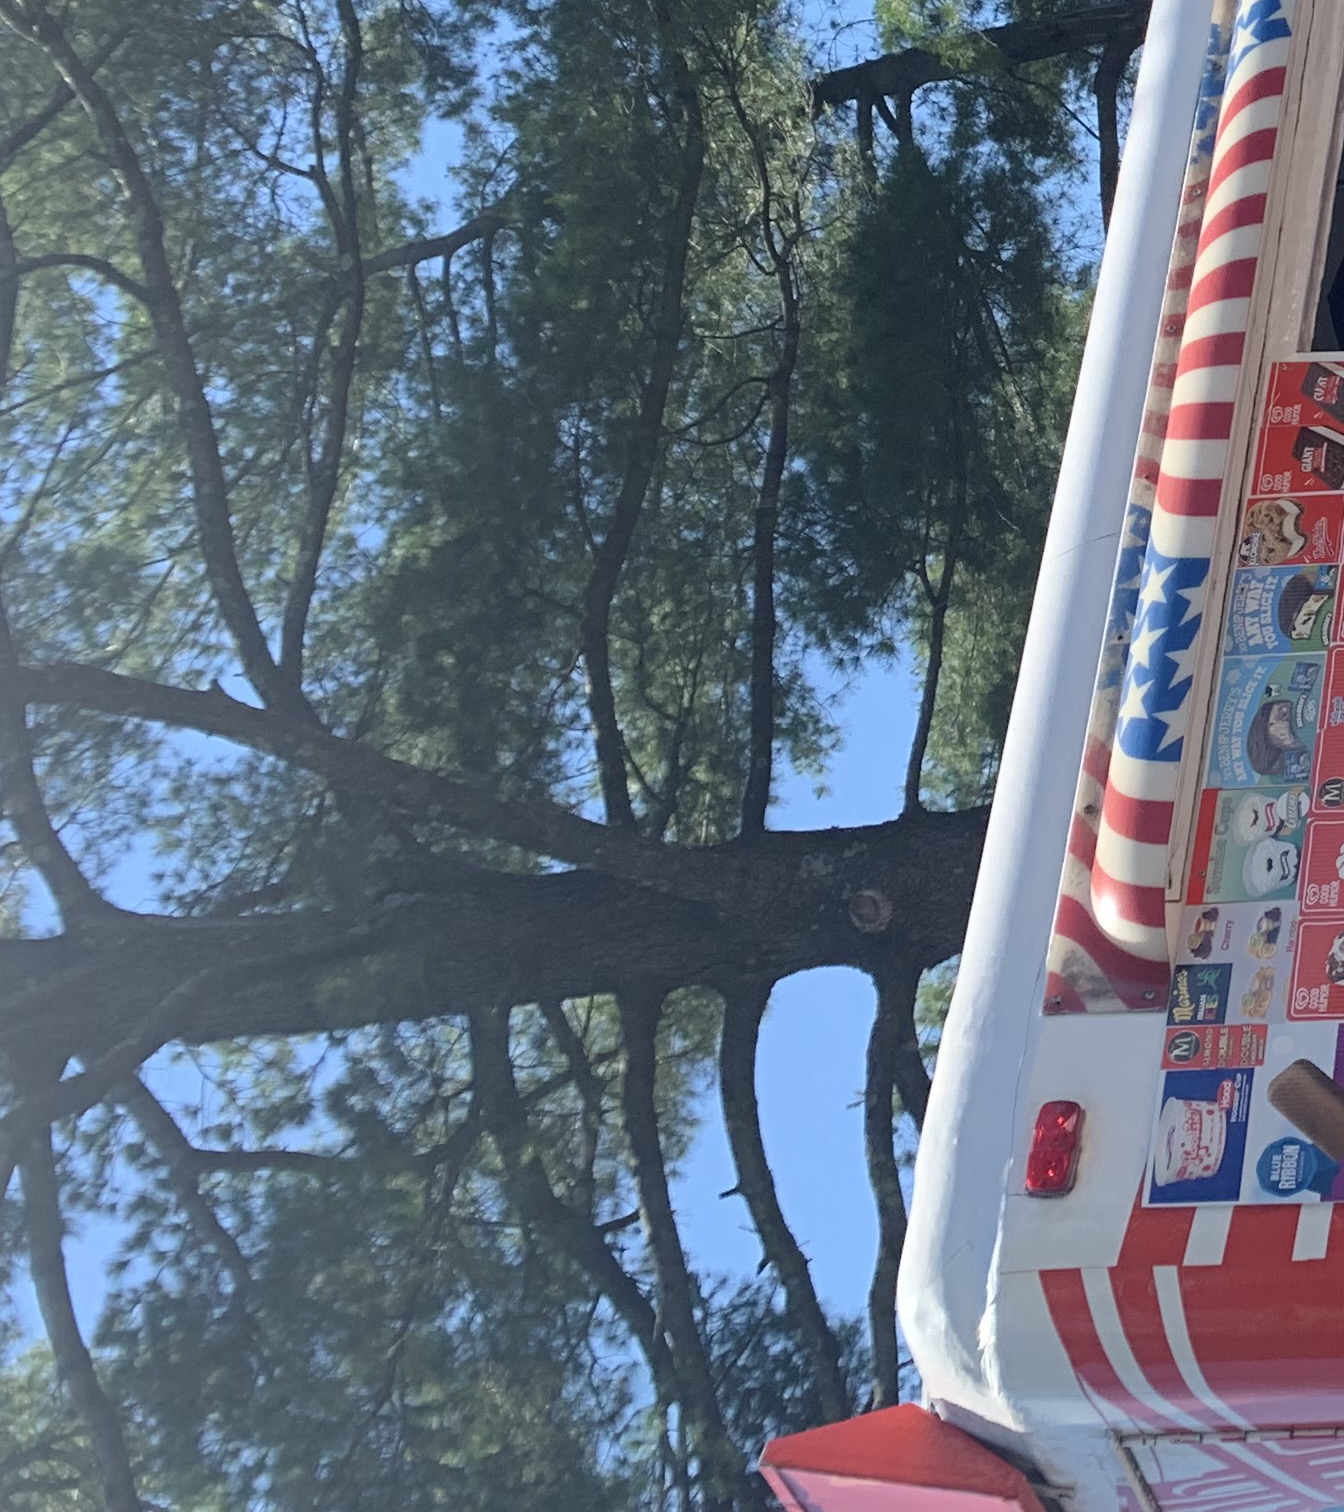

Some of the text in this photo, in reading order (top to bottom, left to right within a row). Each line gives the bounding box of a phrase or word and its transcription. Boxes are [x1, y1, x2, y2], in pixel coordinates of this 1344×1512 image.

[1301, 446, 1314, 472] GIANT
[1248, 580, 1266, 647] ANY WAY
[1261, 592, 1275, 624] SLICE
[1264, 626, 1279, 650] YOU
[1233, 712, 1245, 733] YOU
[1231, 737, 1243, 760] WAY
[1233, 762, 1248, 781] ANY
[1320, 884, 1329, 905] GOOD
[1329, 880, 1340, 907] HUMOR
[1220, 920, 1234, 951] Cherry
[1309, 988, 1320, 1009] GOOD
[1319, 984, 1329, 1012] HUMOR
[1218, 1027, 1229, 1066] DOUBLE
[1240, 1025, 1252, 1065] DOUBLE
[1220, 1081, 1232, 1108] Hood
[1270, 1154, 1281, 1181] BLUE
[1279, 1145, 1300, 1190] RIBBON
